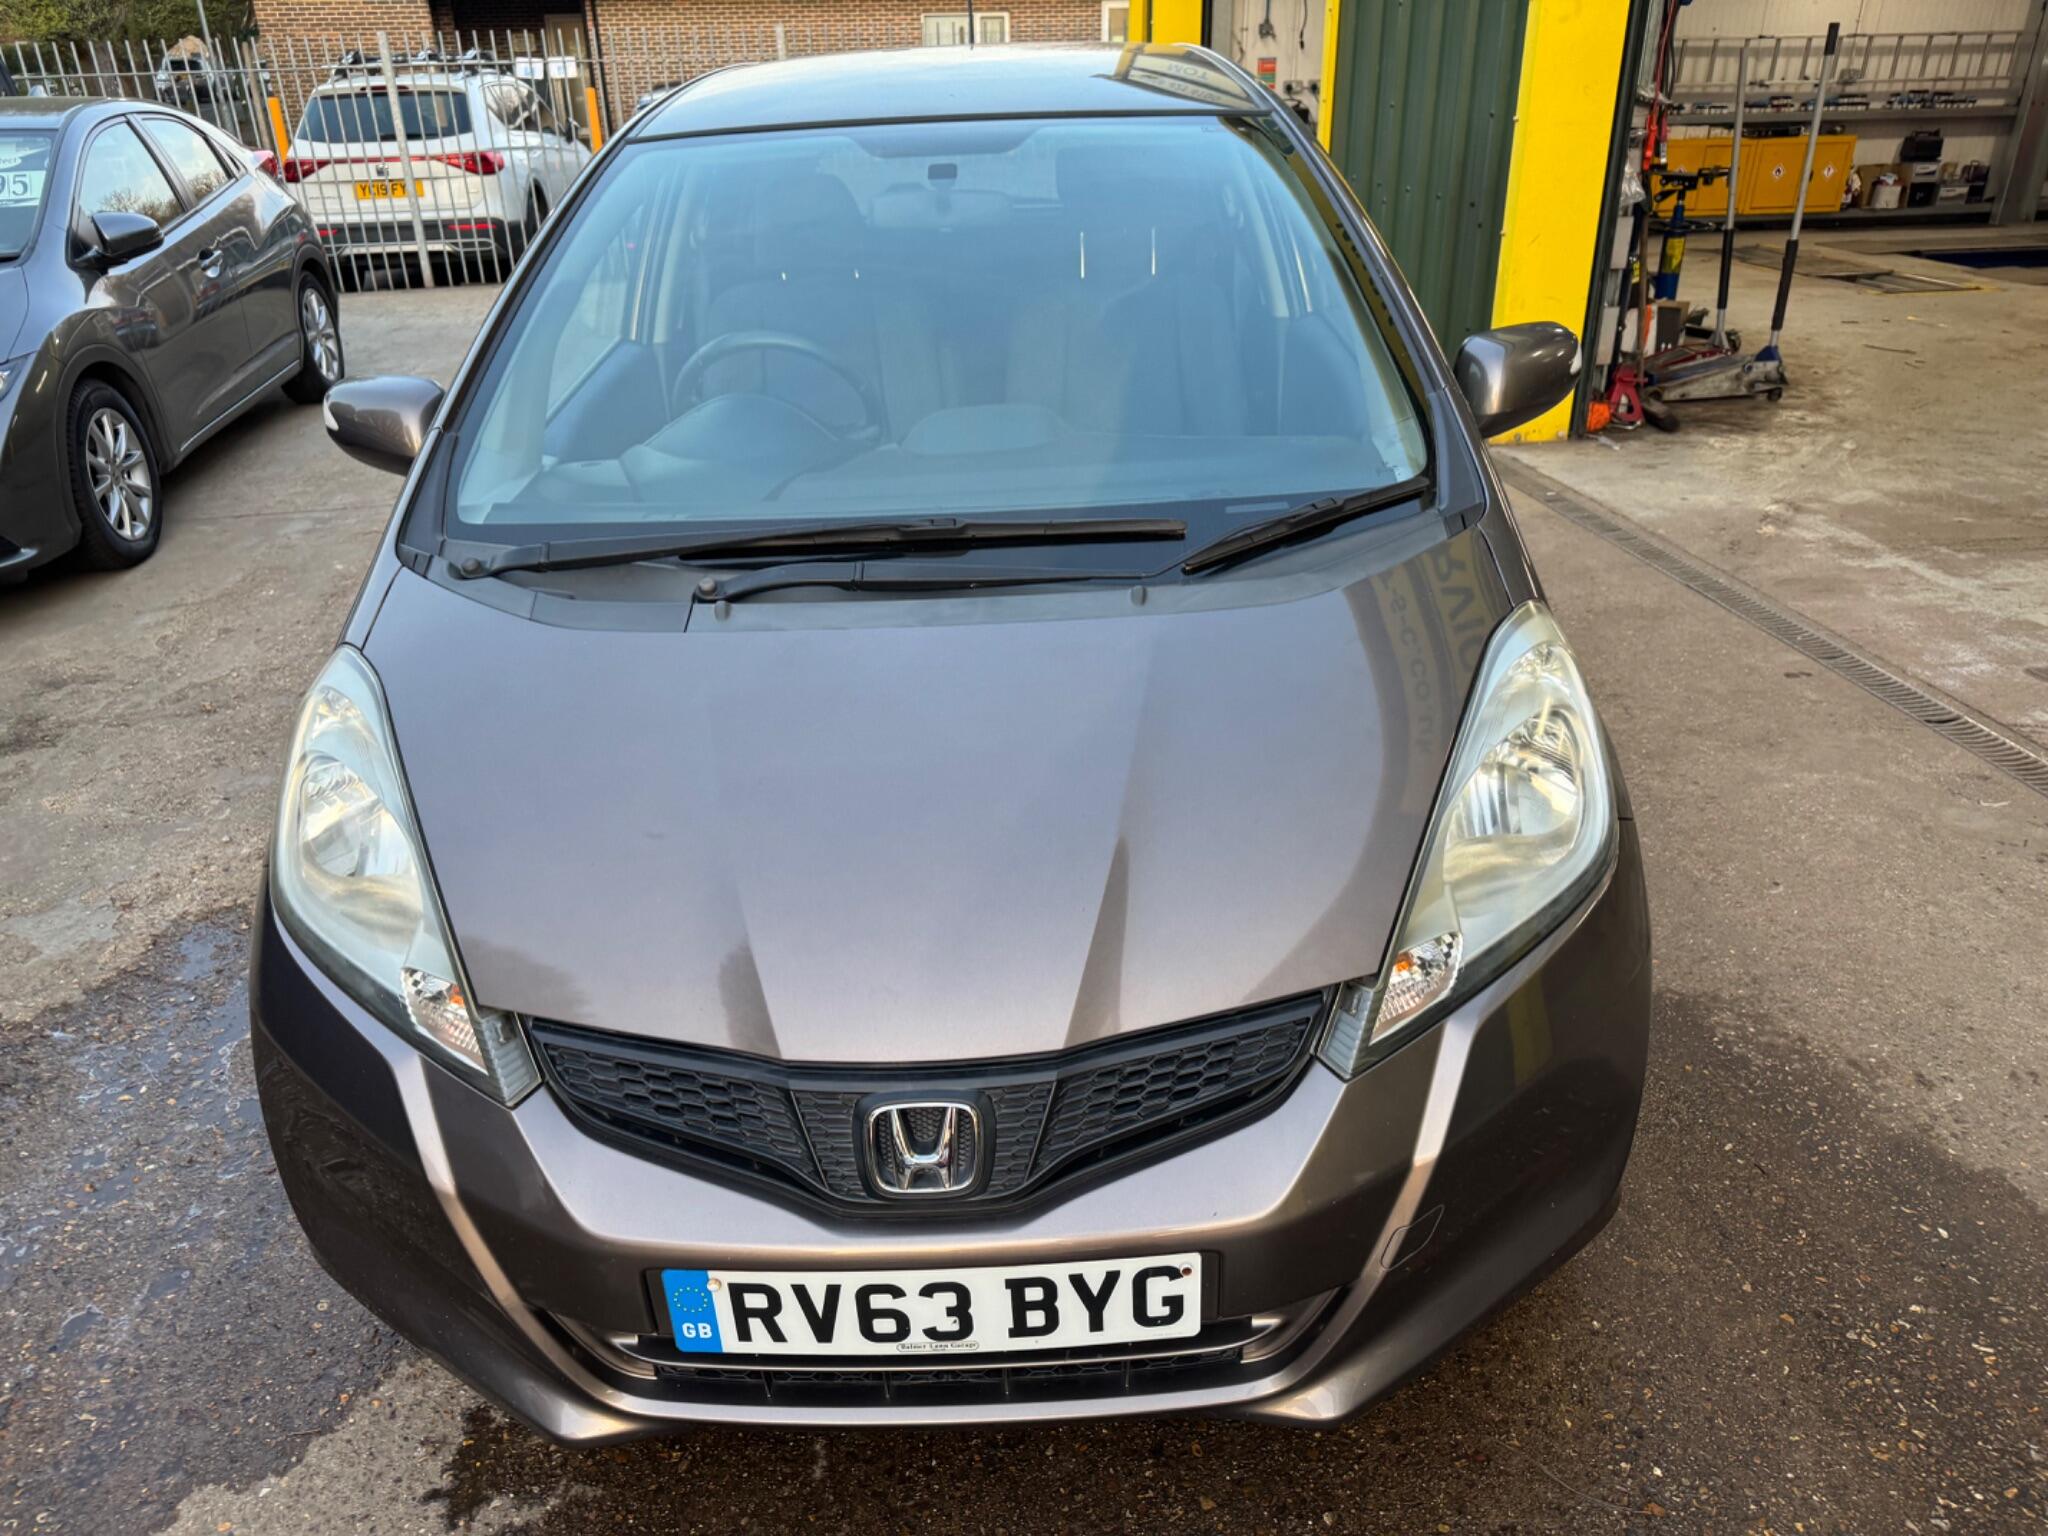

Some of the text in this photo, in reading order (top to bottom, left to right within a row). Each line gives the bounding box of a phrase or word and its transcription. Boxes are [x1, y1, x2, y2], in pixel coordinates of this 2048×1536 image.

[727, 1265, 1184, 1344] RV63 BYG
[682, 1322, 712, 1339] GB
